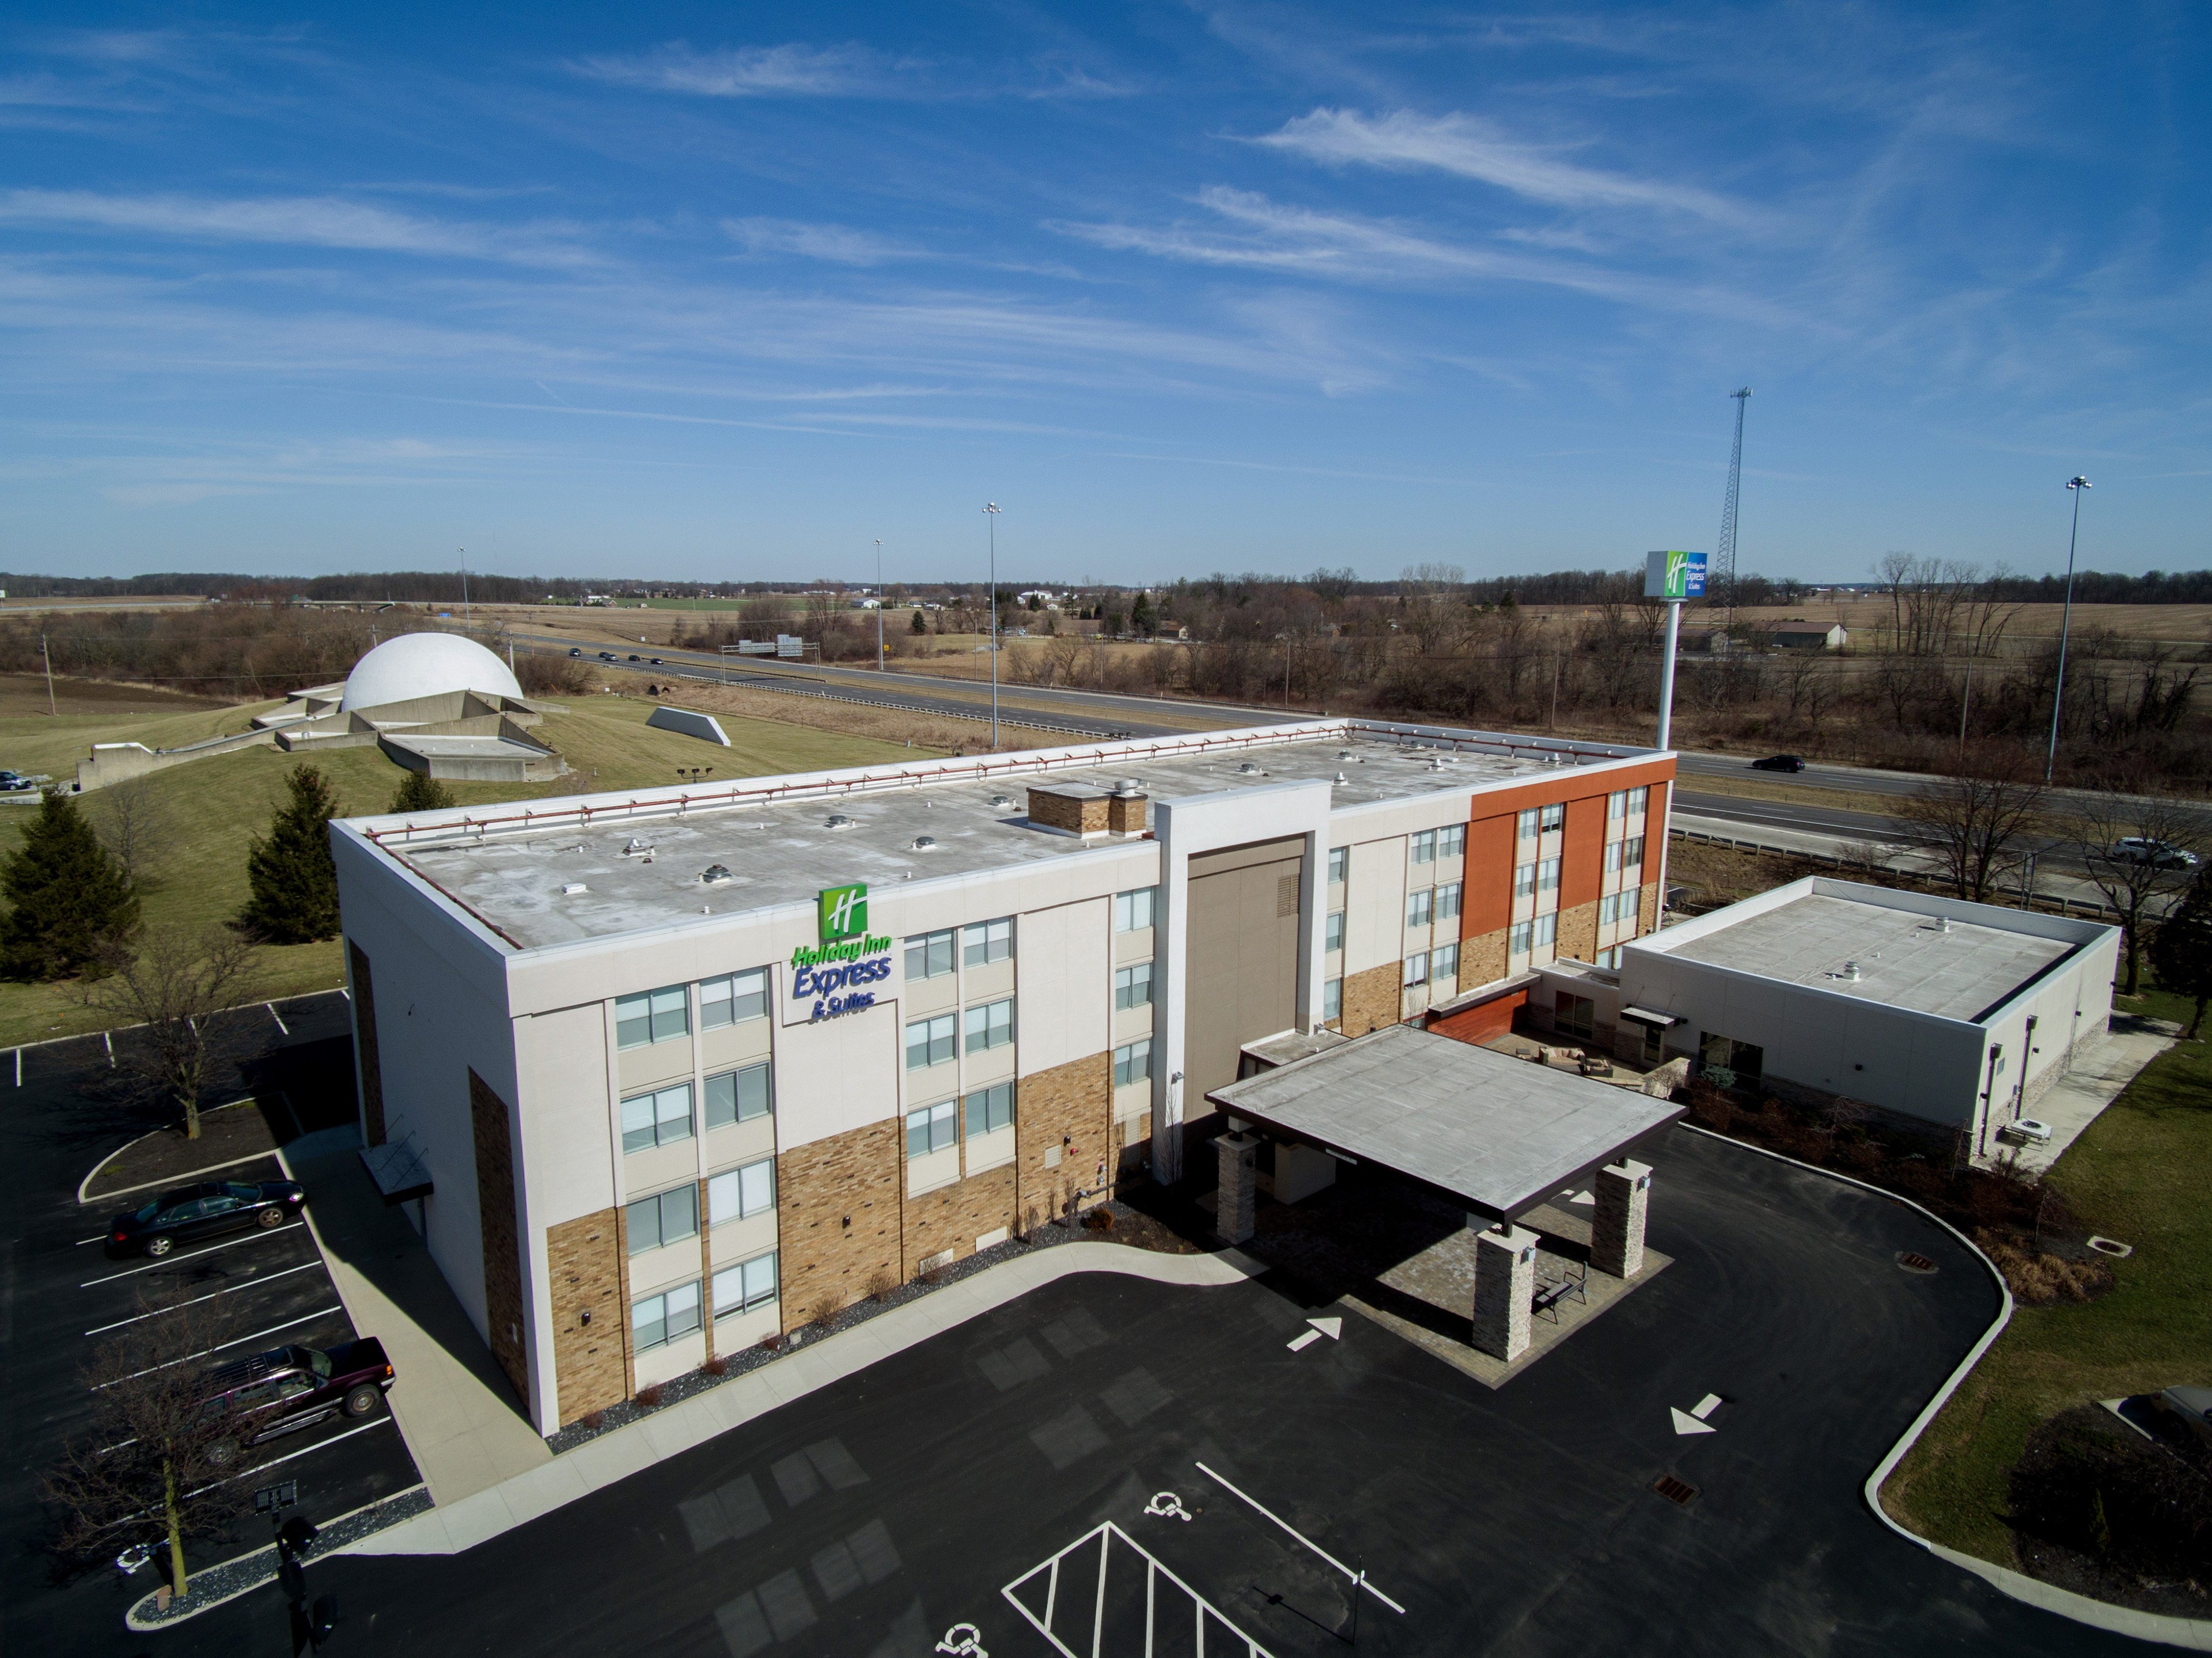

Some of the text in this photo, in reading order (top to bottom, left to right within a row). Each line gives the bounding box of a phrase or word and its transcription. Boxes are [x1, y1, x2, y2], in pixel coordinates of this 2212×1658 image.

[1686, 570, 1705, 582] Express
[828, 889, 867, 933] H
[791, 934, 892, 967] Holiday Inn
[793, 957, 892, 998] Express
[813, 992, 875, 1019] & Suites
